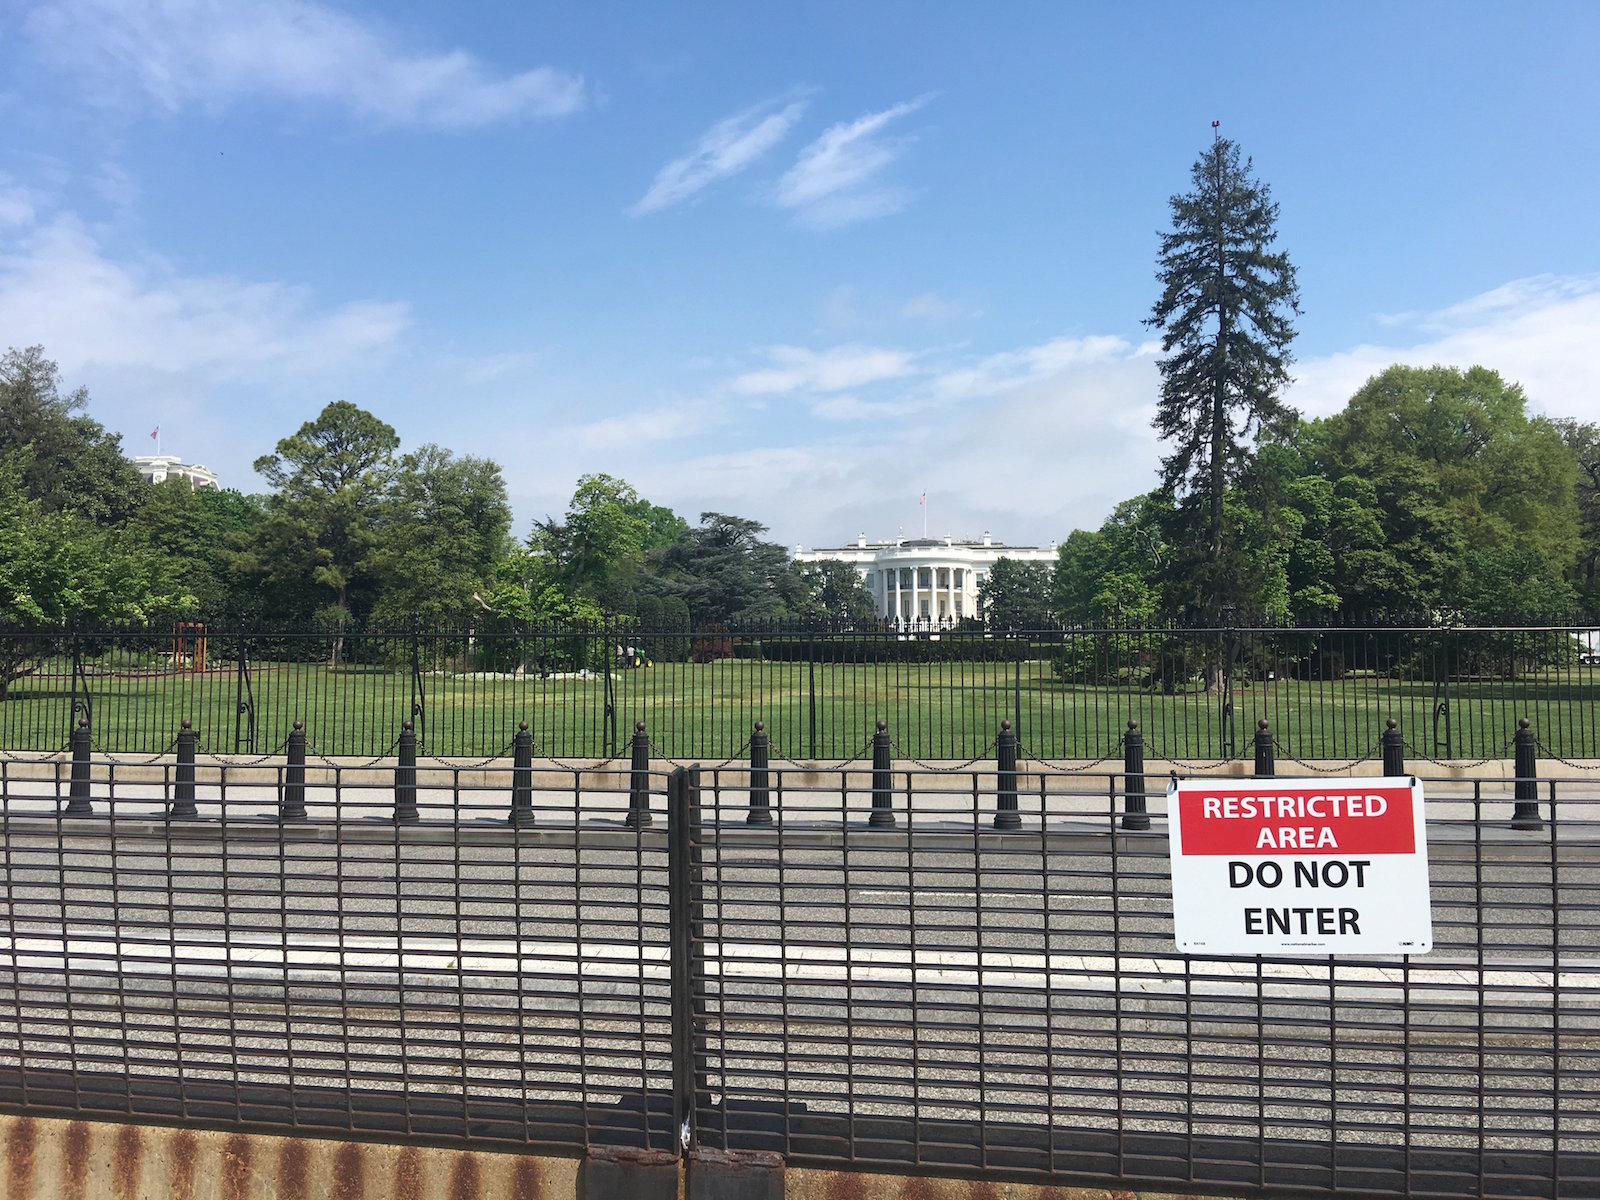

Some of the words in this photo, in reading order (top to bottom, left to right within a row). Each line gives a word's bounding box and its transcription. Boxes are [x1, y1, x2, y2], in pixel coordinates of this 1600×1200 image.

[1203, 795, 1388, 819] RESTRICTED
[1256, 827, 1338, 849] AREA
[1228, 861, 1283, 888] DO
[1294, 860, 1371, 888] NOT
[1244, 907, 1361, 935] ENTER
